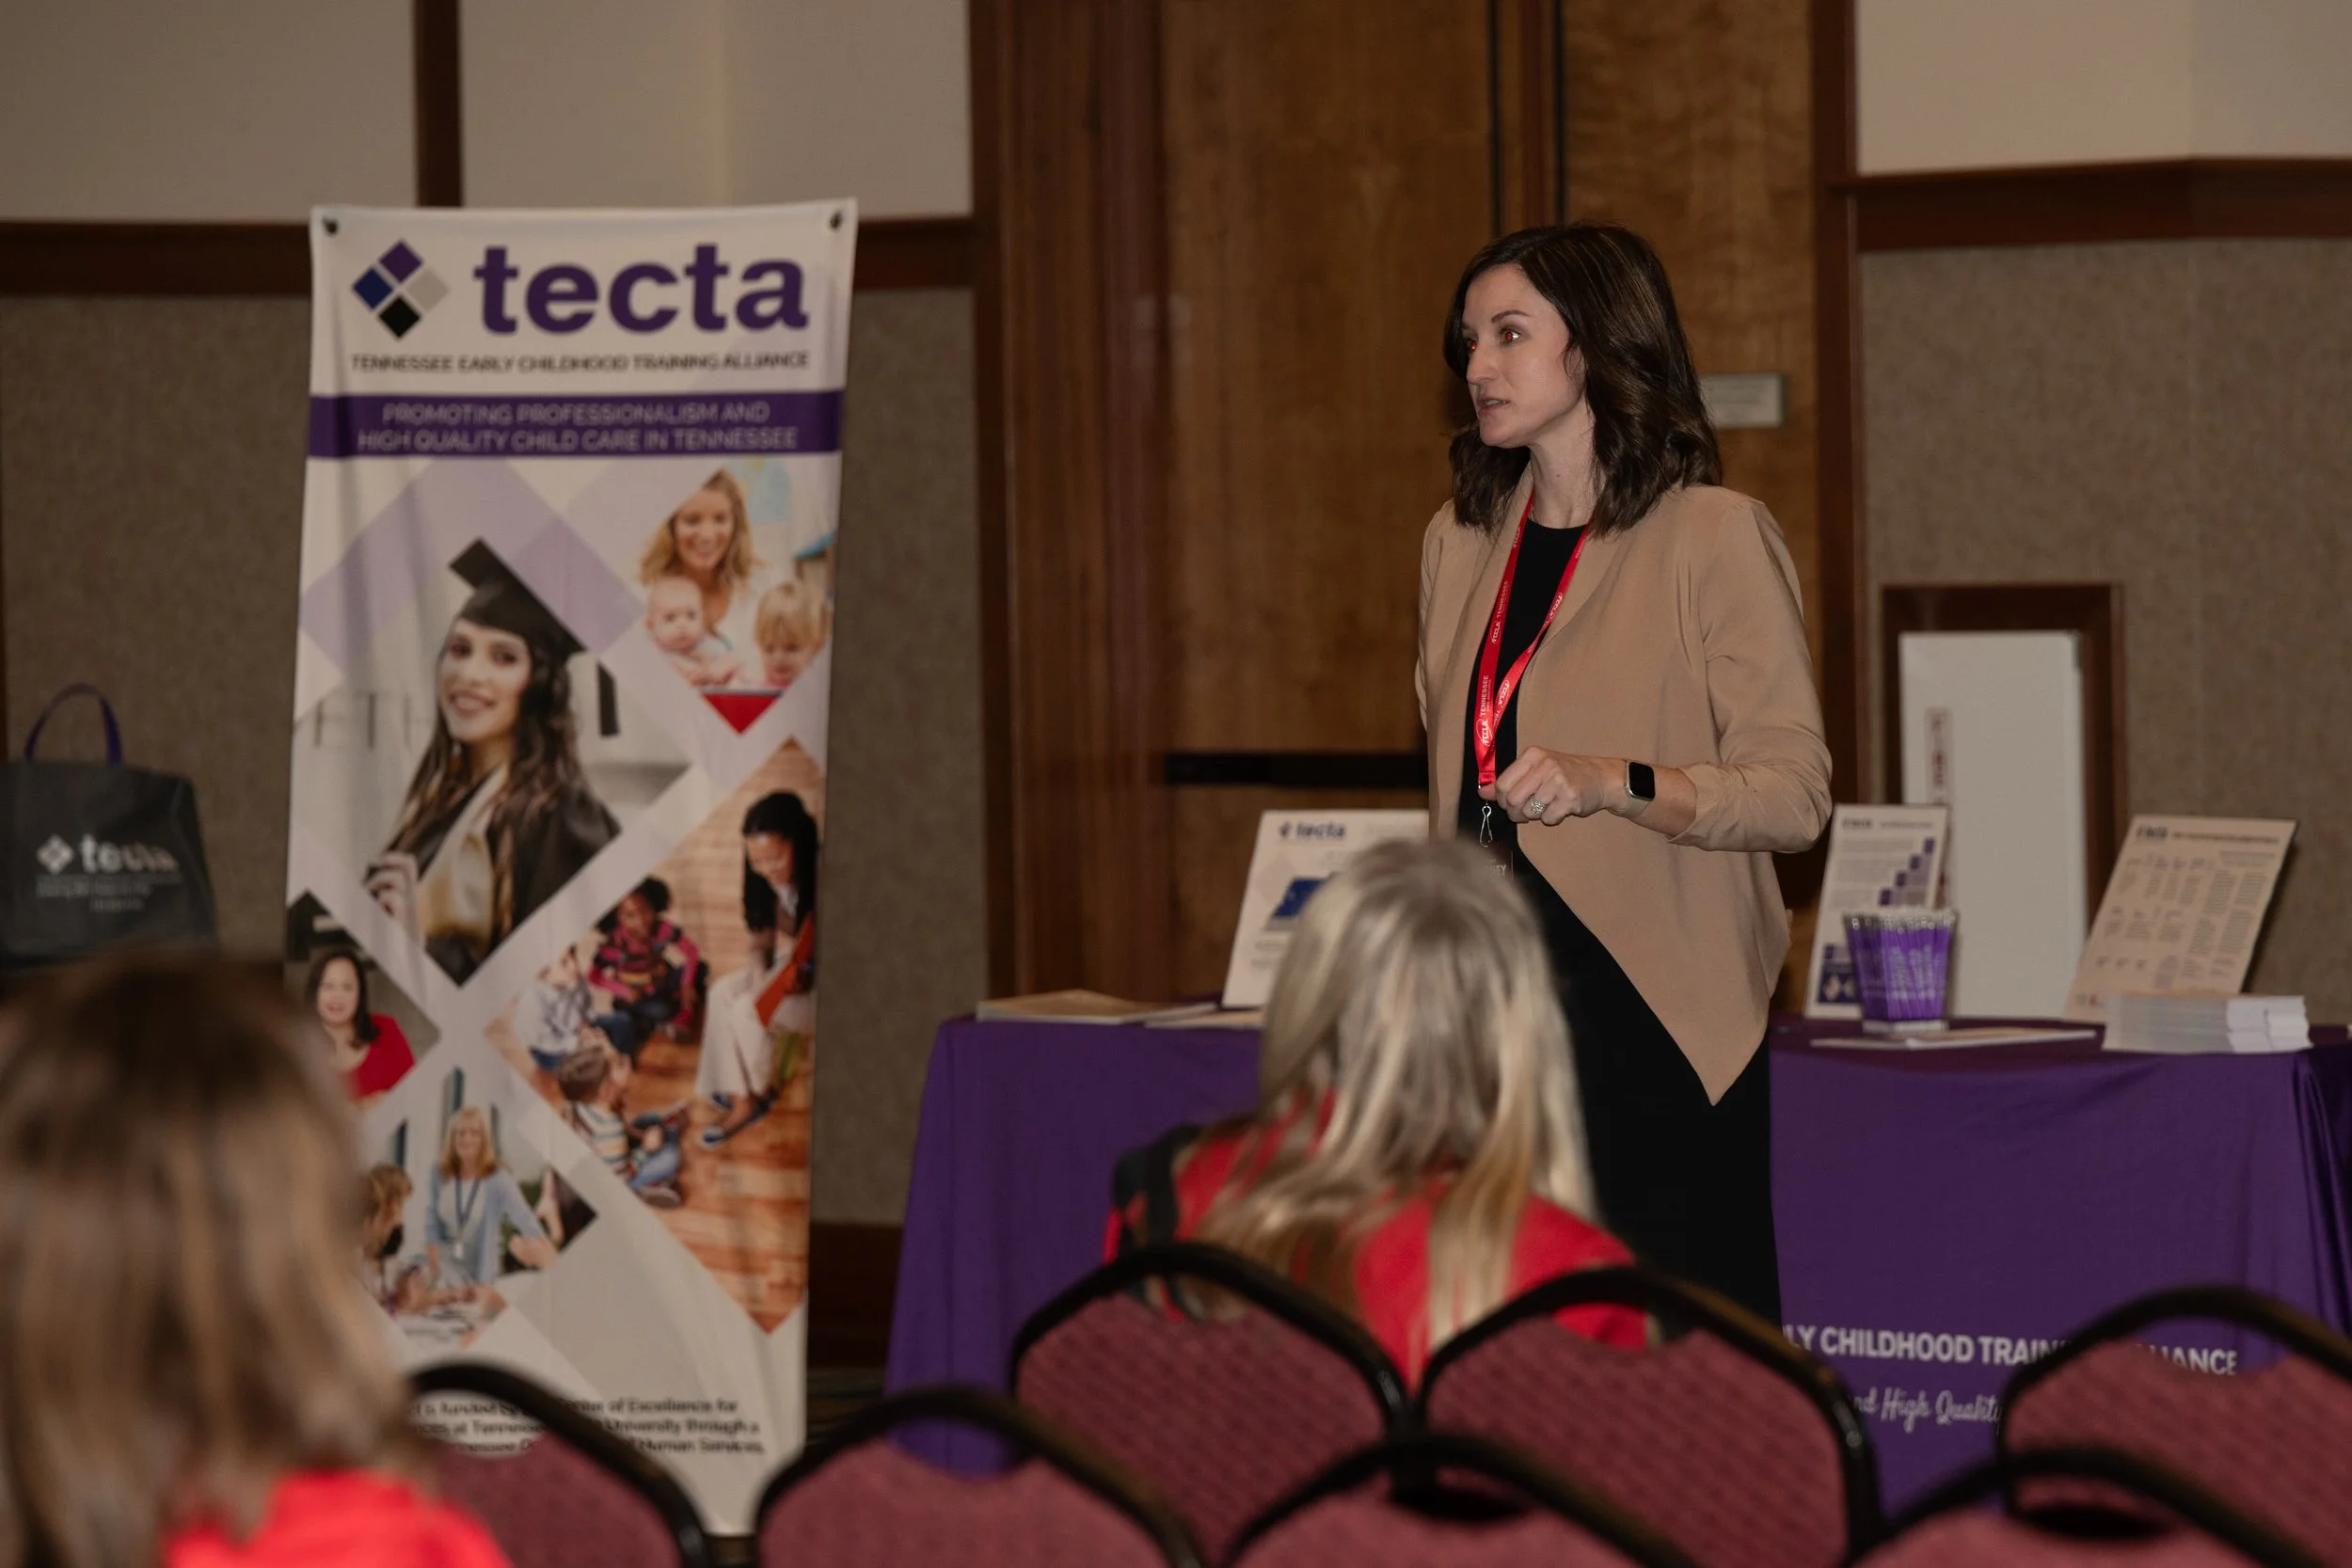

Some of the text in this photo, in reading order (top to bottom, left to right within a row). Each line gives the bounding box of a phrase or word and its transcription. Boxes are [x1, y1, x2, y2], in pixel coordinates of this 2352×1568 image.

[473, 244, 809, 335] tecta
[352, 351, 811, 374] TENNESSEE EARLY CHILDHOOD TRAINING ALLIANCE
[382, 400, 771, 426] PROMOTING PROFESSIONALISM AND
[358, 425, 799, 452] HIGH QUALITY CHILD CARE IN TENNESSEE
[1480, 675, 1490, 745] FCCLA TENNESSEE
[1820, 1326, 1975, 1363] CHILDHOOD
[1881, 1387, 1931, 1434] High
